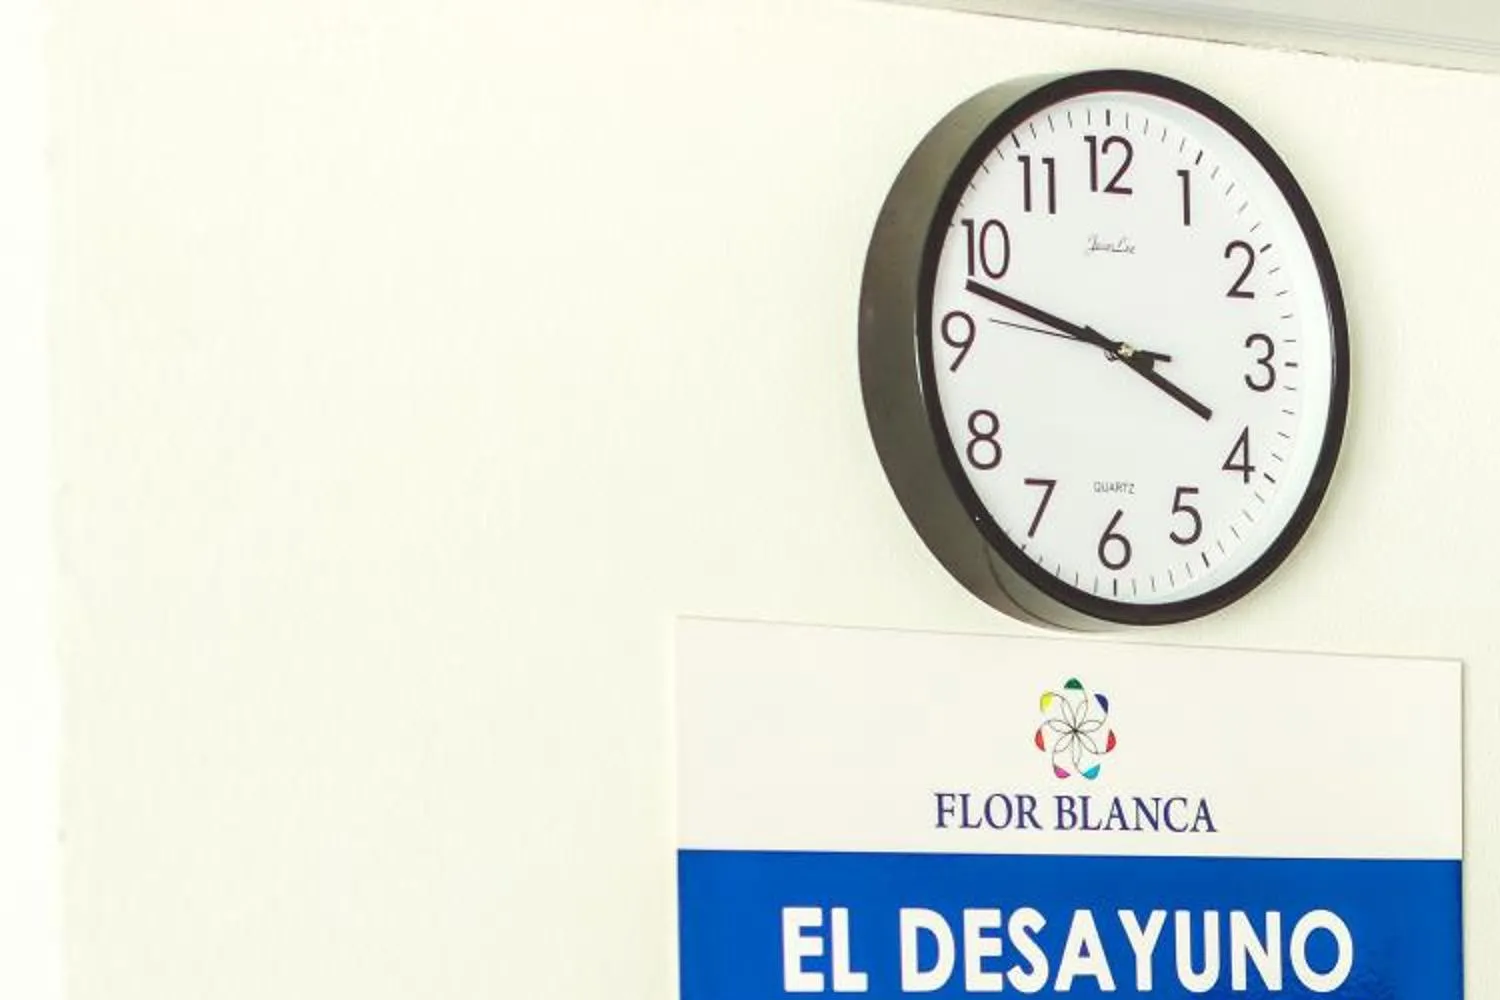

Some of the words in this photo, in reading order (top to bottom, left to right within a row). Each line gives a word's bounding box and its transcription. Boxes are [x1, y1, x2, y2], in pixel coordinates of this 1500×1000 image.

[1017, 155, 1056, 215] 11
[1083, 135, 1134, 195] 12
[1176, 169, 1192, 226] 1
[960, 218, 1011, 280] 10
[1223, 240, 1256, 299] 2
[941, 310, 976, 372] 9
[1244, 333, 1276, 393] 3
[966, 409, 1002, 471] 8
[1221, 426, 1256, 484] 4
[1023, 478, 1057, 538] 7
[1093, 481, 1135, 495] QUARTZ
[1169, 486, 1203, 546] 5
[1097, 509, 1132, 571] 6
[934, 792, 1044, 831] FLOR
[1053, 795, 1218, 834] BLANCA
[781, 906, 869, 993] EL
[899, 907, 1354, 994] DESAYUNO
